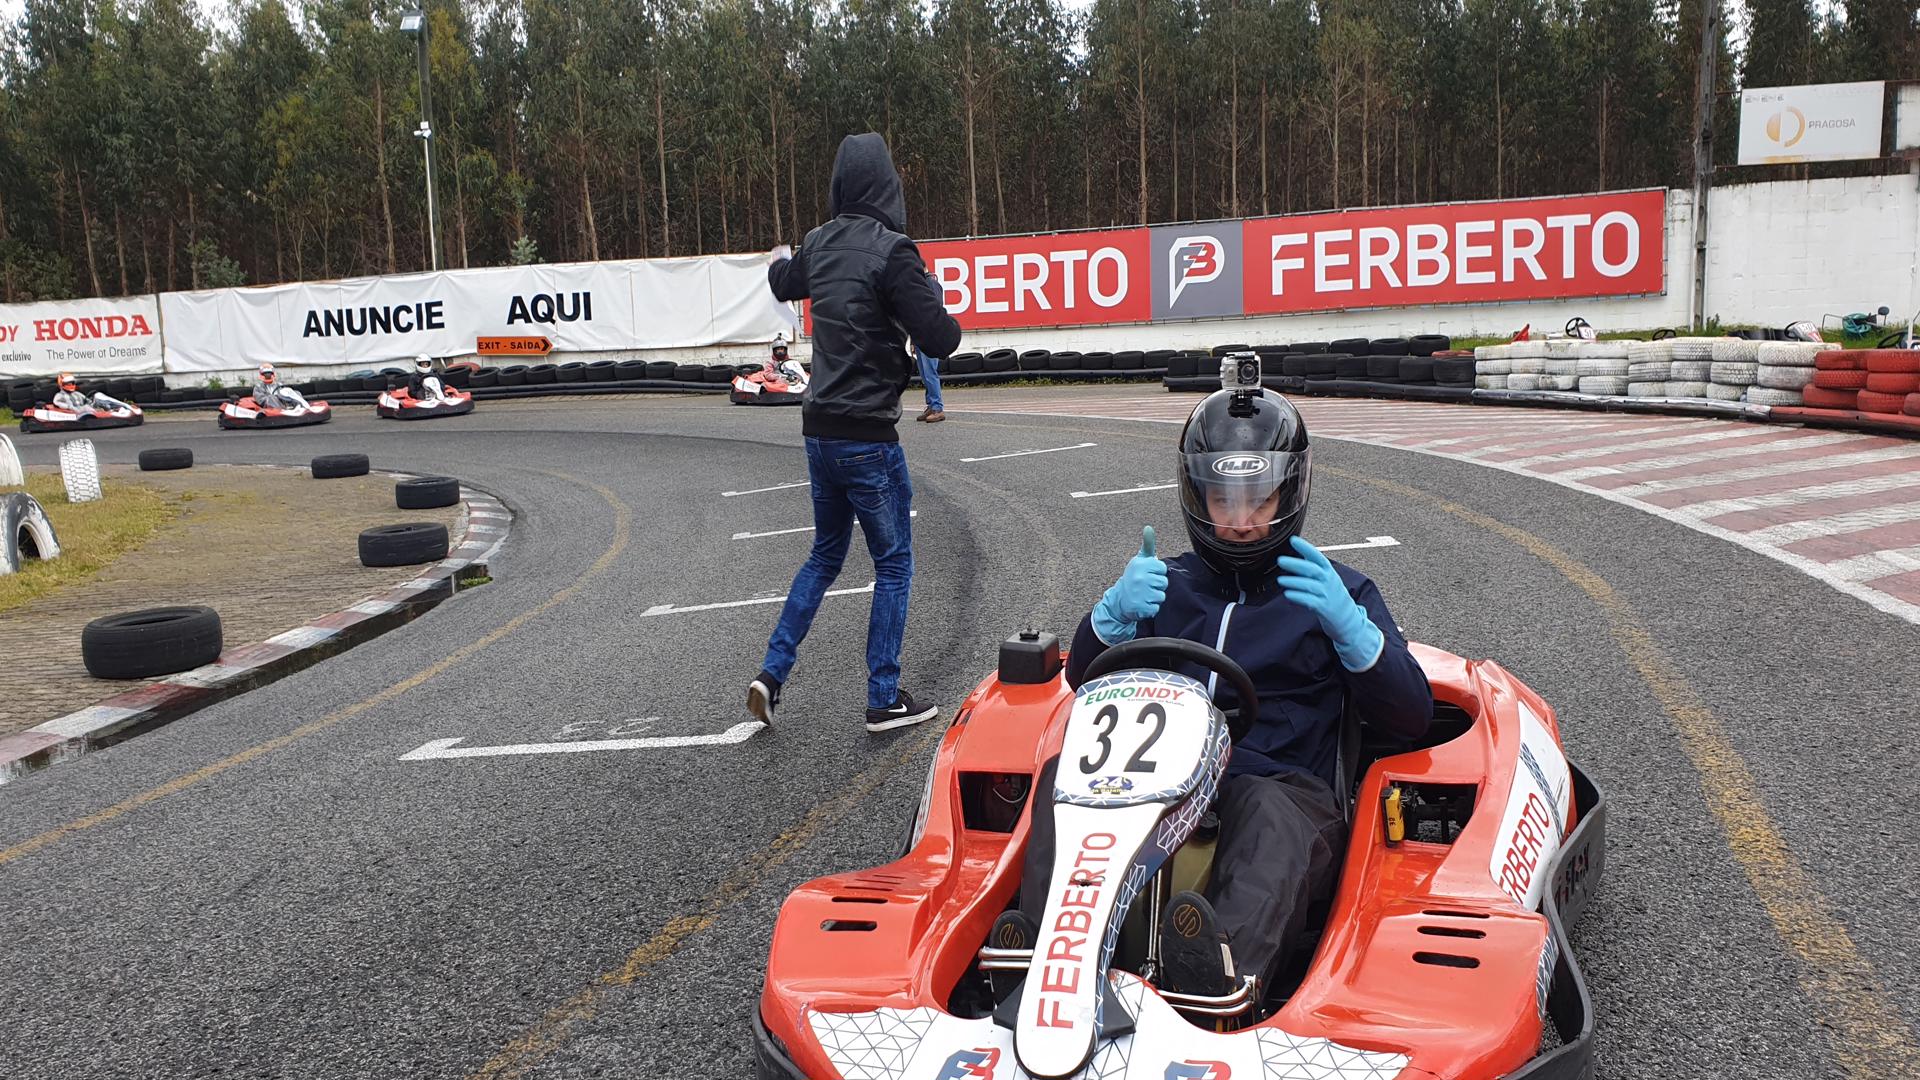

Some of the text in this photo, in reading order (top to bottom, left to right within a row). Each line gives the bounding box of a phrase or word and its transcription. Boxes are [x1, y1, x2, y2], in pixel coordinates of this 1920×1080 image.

[1807, 117, 1857, 130] PRAGOSA
[1271, 210, 1640, 296] FERBERTO
[934, 247, 1129, 315] BERTO
[33, 314, 153, 342] HONDA
[302, 291, 593, 338] ANUNCIE AQUI
[1, 350, 32, 362] exclusivo
[46, 345, 147, 360] The Power of Dreams
[478, 341, 501, 350] EXIT
[510, 339, 541, 350] SAÍDA
[1220, 459, 1261, 472] HJC
[1085, 686, 1185, 706] EUROINDY
[1079, 702, 1167, 775] 32
[1499, 792, 1550, 905] RBERTO
[1036, 832, 1117, 1029] FERBERTO
